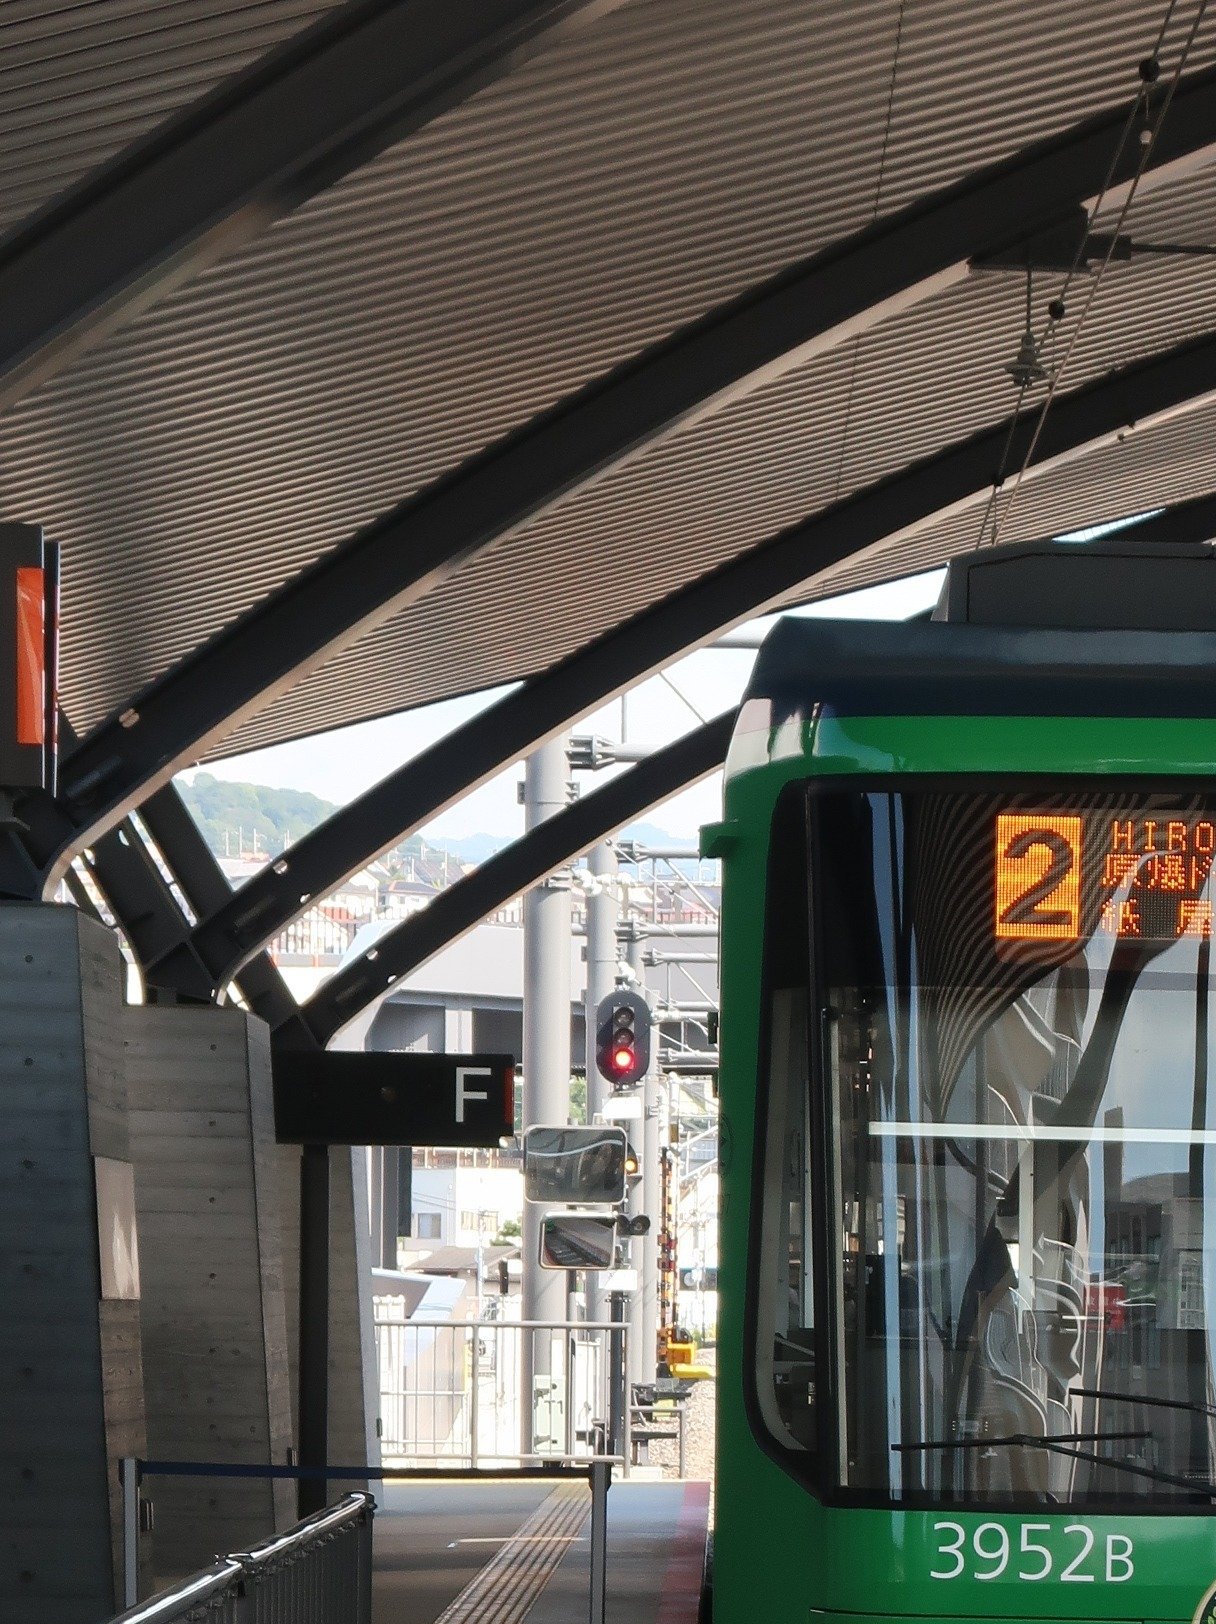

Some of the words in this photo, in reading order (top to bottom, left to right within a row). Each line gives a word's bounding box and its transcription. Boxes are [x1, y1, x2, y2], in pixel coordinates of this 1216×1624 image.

[1001, 827, 1073, 926] 2
[455, 1067, 492, 1122] F
[929, 1521, 1135, 1583] 3952B
